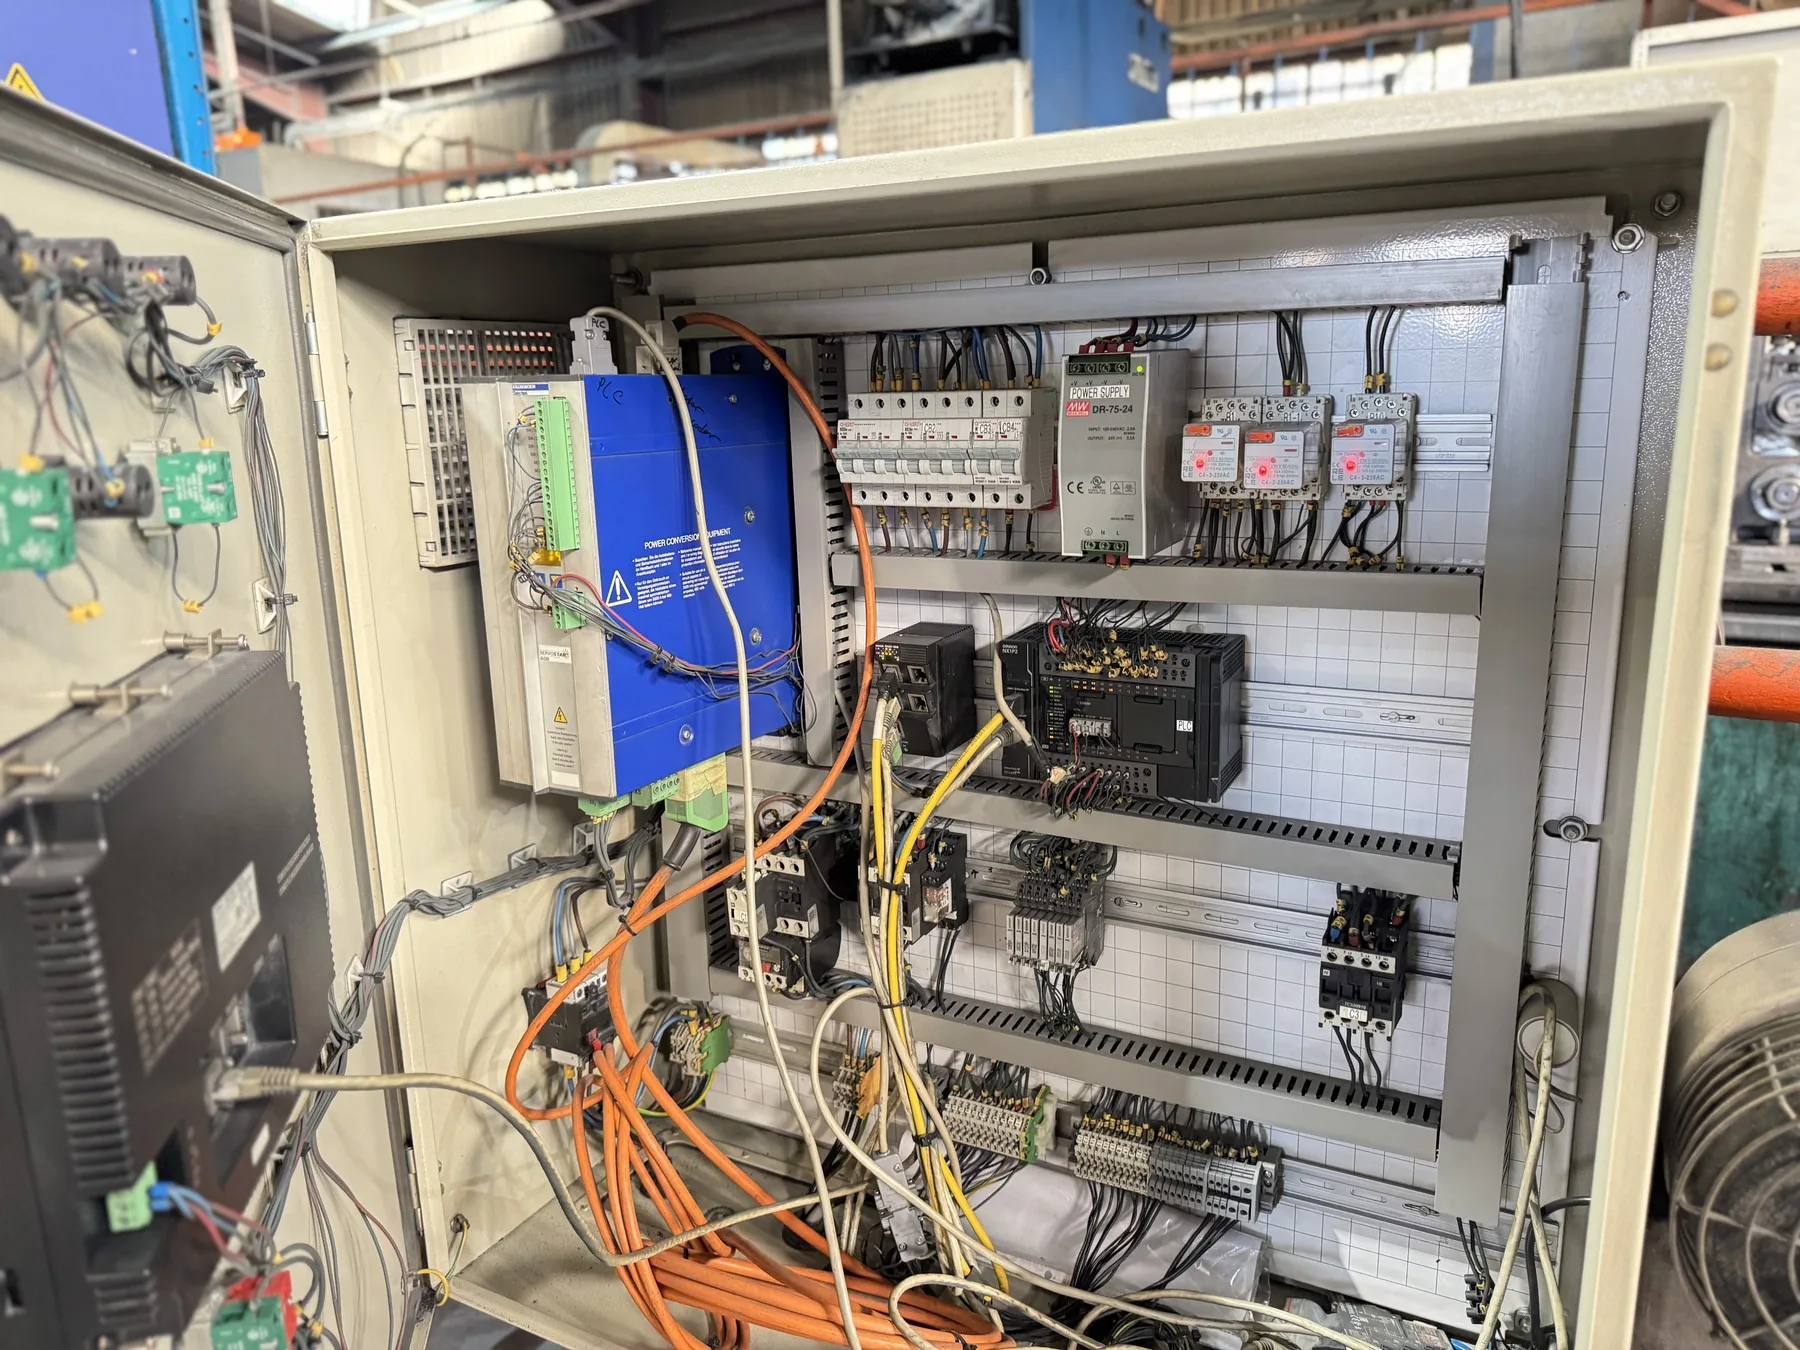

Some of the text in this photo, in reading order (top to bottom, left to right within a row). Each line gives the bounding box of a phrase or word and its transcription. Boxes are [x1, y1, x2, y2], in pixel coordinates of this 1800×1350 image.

[592, 318, 606, 328] PLC
[1072, 386, 1129, 399] POWER SUPPLY
[1067, 402, 1089, 411] MW
[1092, 405, 1133, 414] DR-75-24
[923, 422, 936, 434] CB2
[980, 424, 991, 434] CB3
[1003, 422, 1016, 433] CB4
[1067, 481, 1084, 494] CE
[644, 539, 666, 549] POWER
[1178, 721, 1192, 730] PLC
[1350, 1009, 1359, 1019] C3
